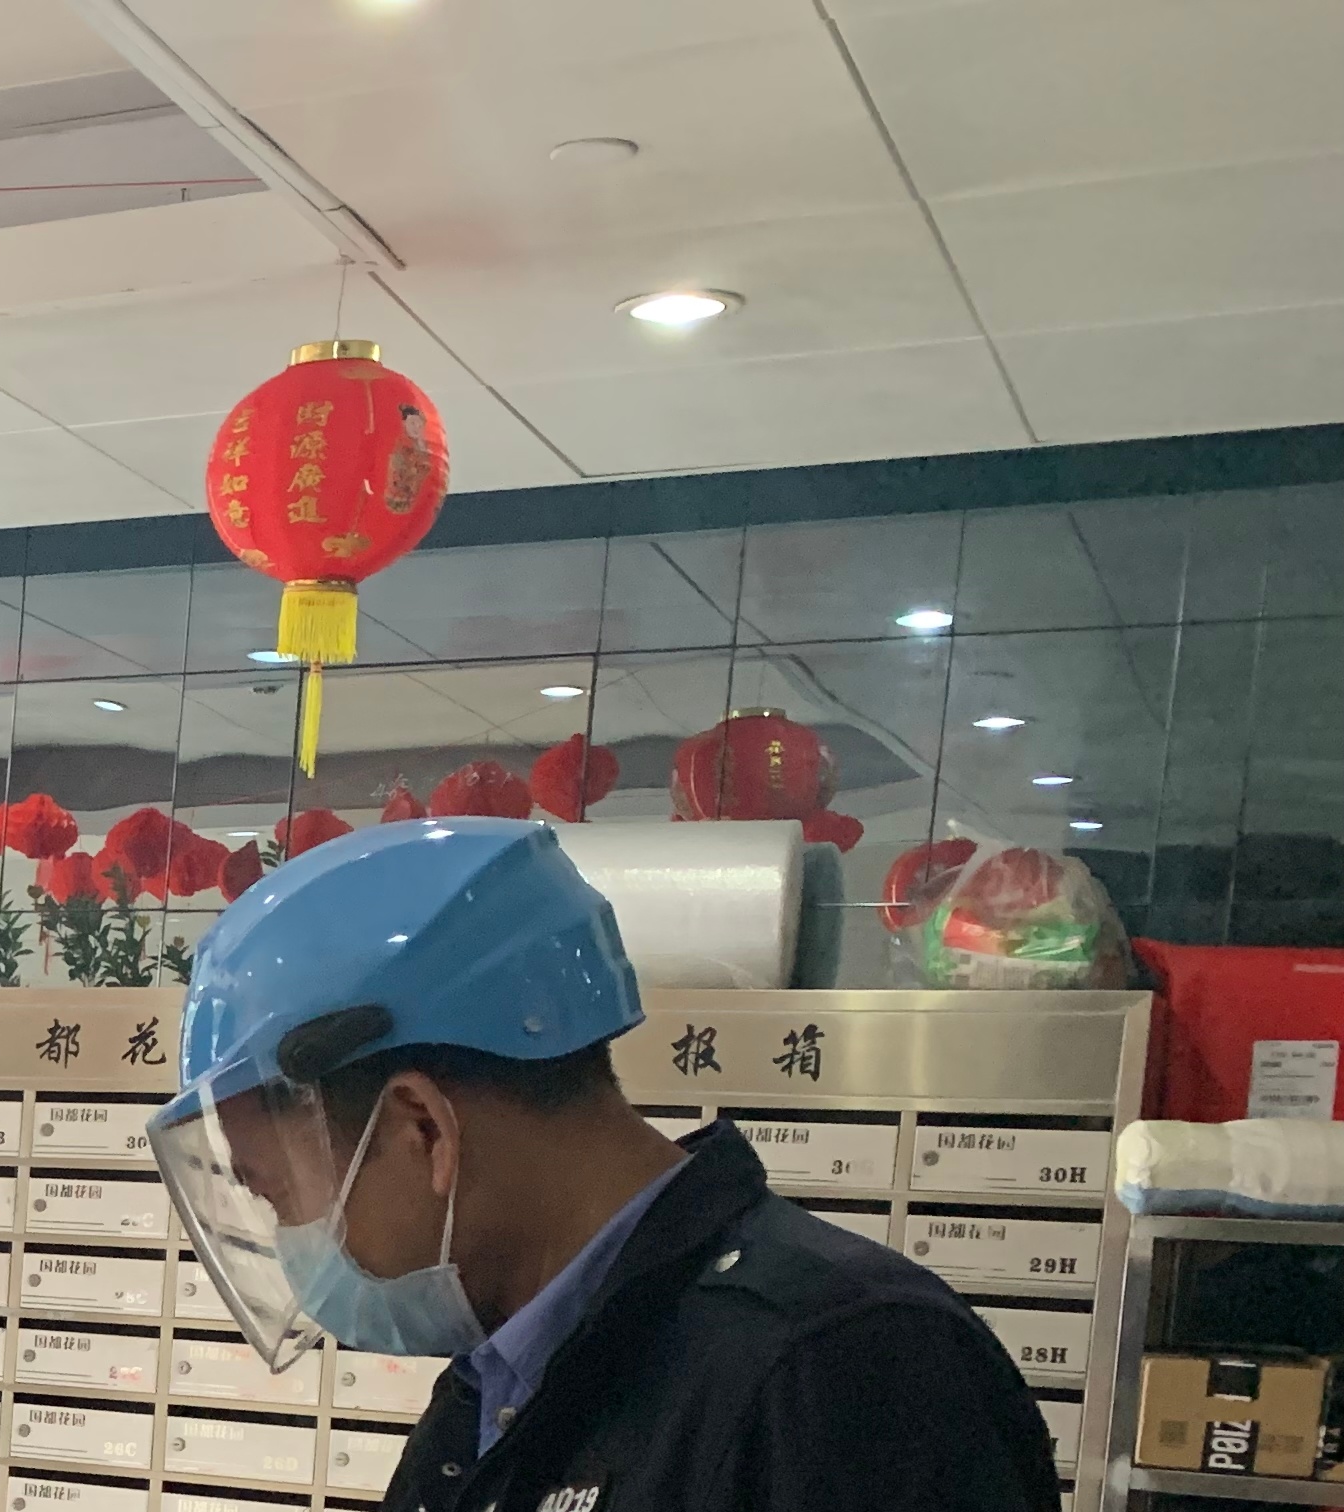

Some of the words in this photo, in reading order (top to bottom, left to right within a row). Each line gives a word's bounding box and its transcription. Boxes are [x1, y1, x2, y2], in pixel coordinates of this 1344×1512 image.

[1039, 1166, 1088, 1185] 30H
[1029, 1257, 1078, 1275] 29H
[1020, 1346, 1069, 1364] 28H
